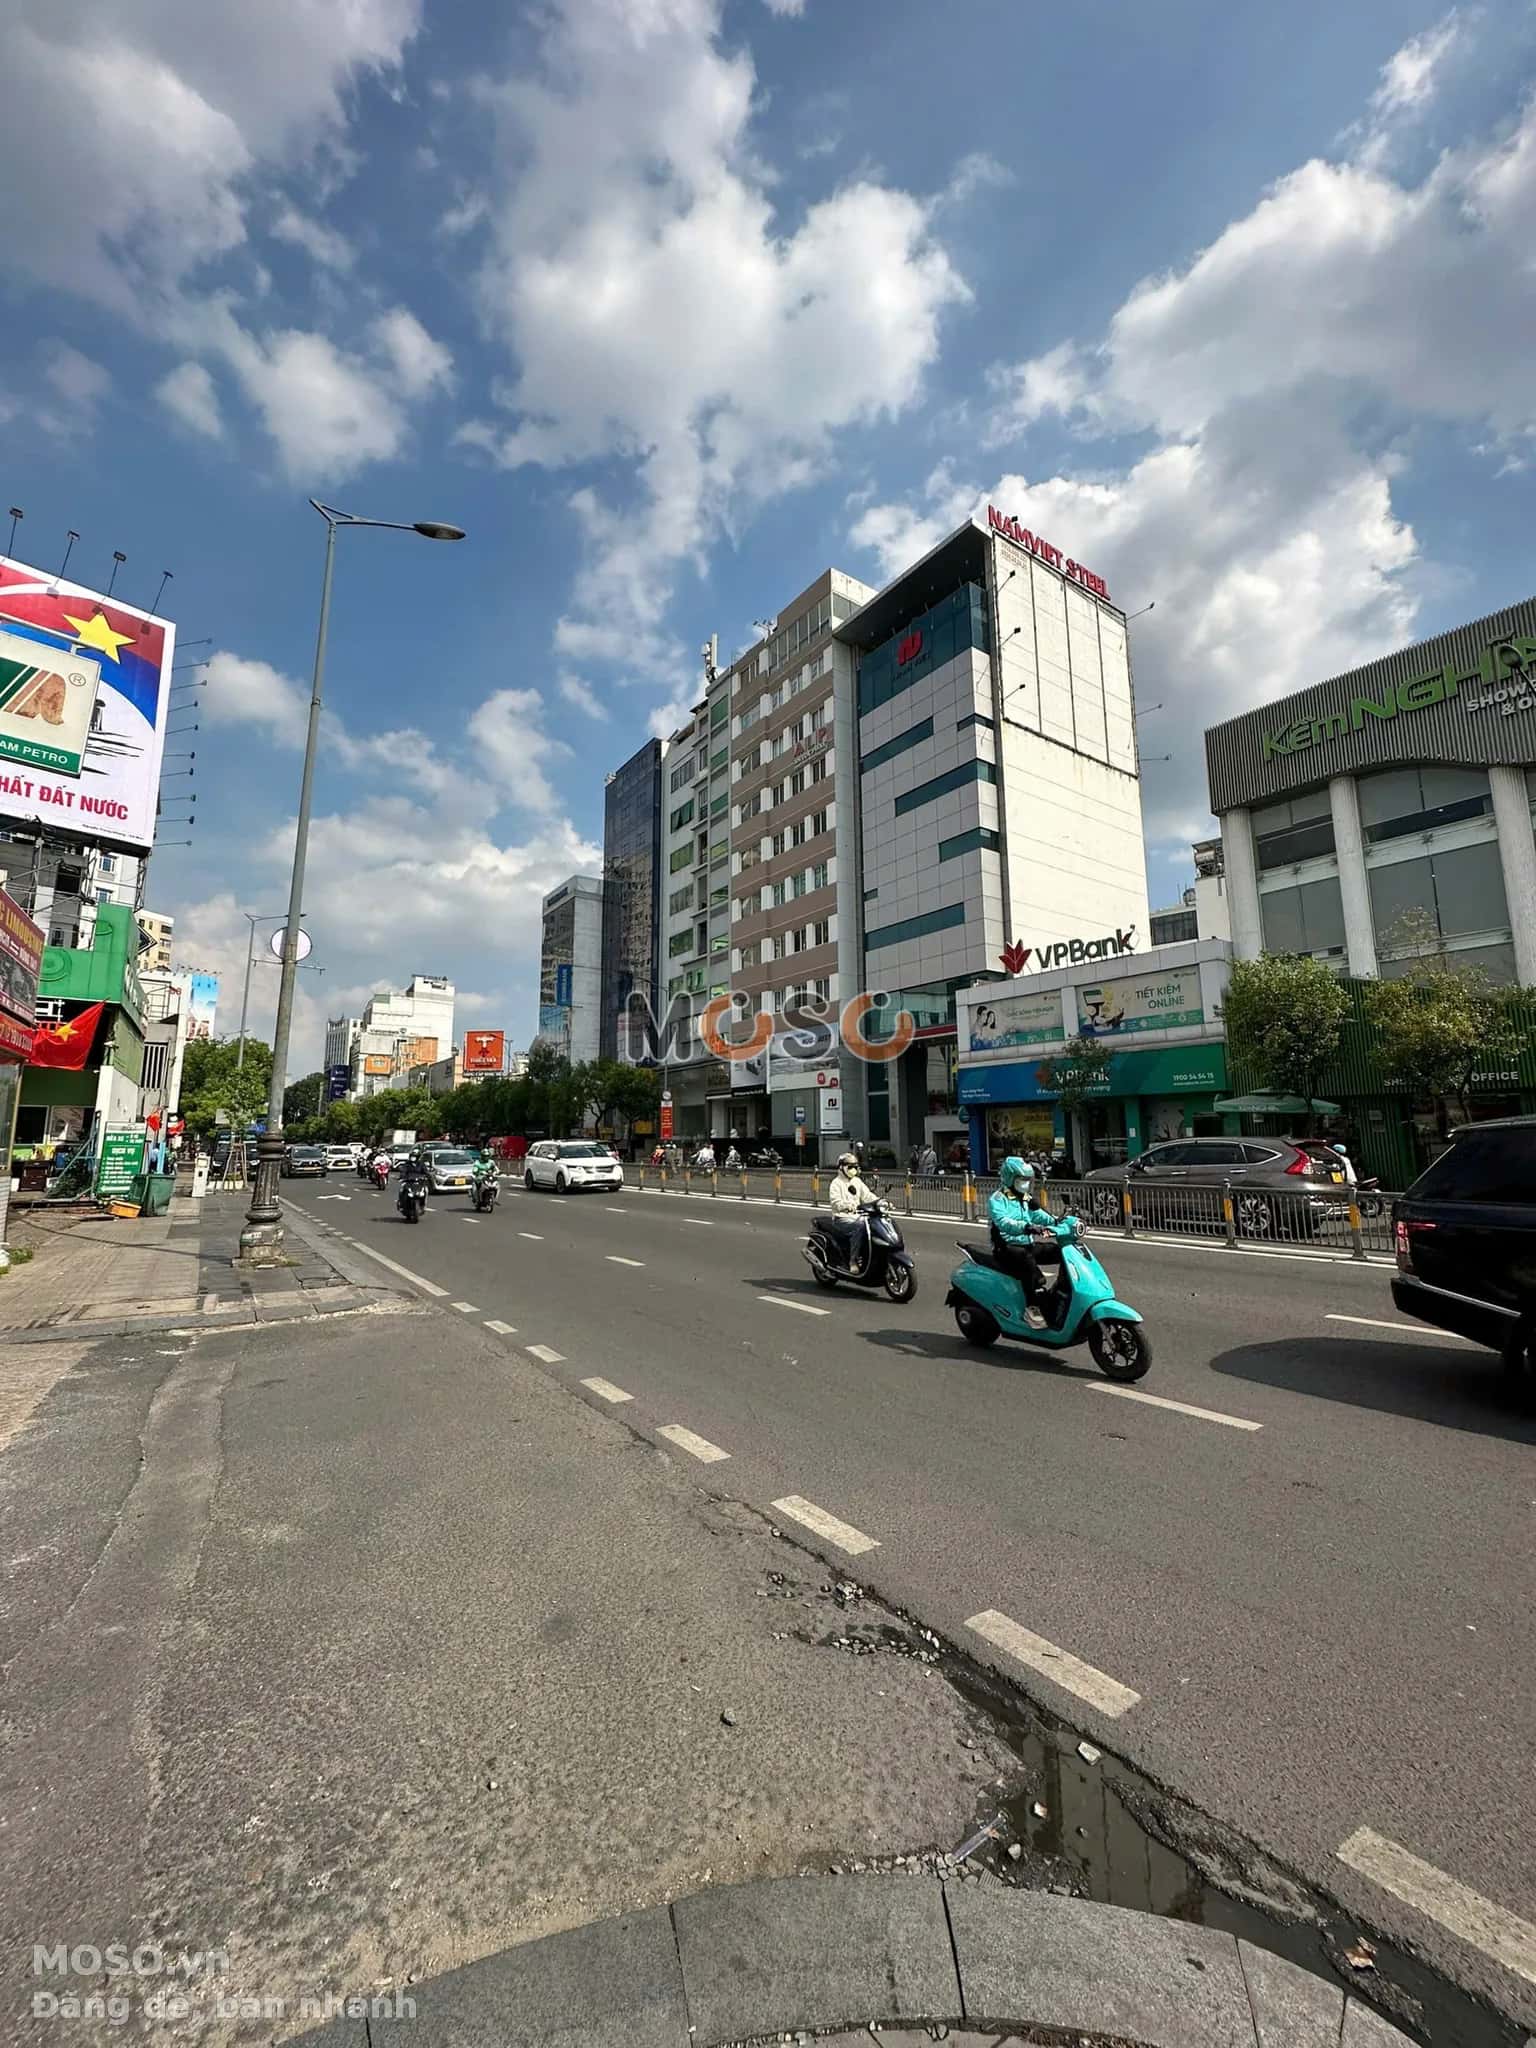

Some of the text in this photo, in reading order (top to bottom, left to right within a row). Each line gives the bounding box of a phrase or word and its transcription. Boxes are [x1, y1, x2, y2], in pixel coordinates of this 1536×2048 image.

[1066, 558, 1111, 600] STEEL
[1518, 696, 1536, 710] O
[22, 747, 69, 765] PETRO
[38, 785, 76, 807] ĐẤT
[80, 796, 129, 820] NƯỚC
[1035, 928, 1138, 969] VPBank
[1148, 996, 1185, 1009] ONLINE
[1055, 1067, 1111, 1084] VPnk
[1471, 1071, 1520, 1082] OFFICE
